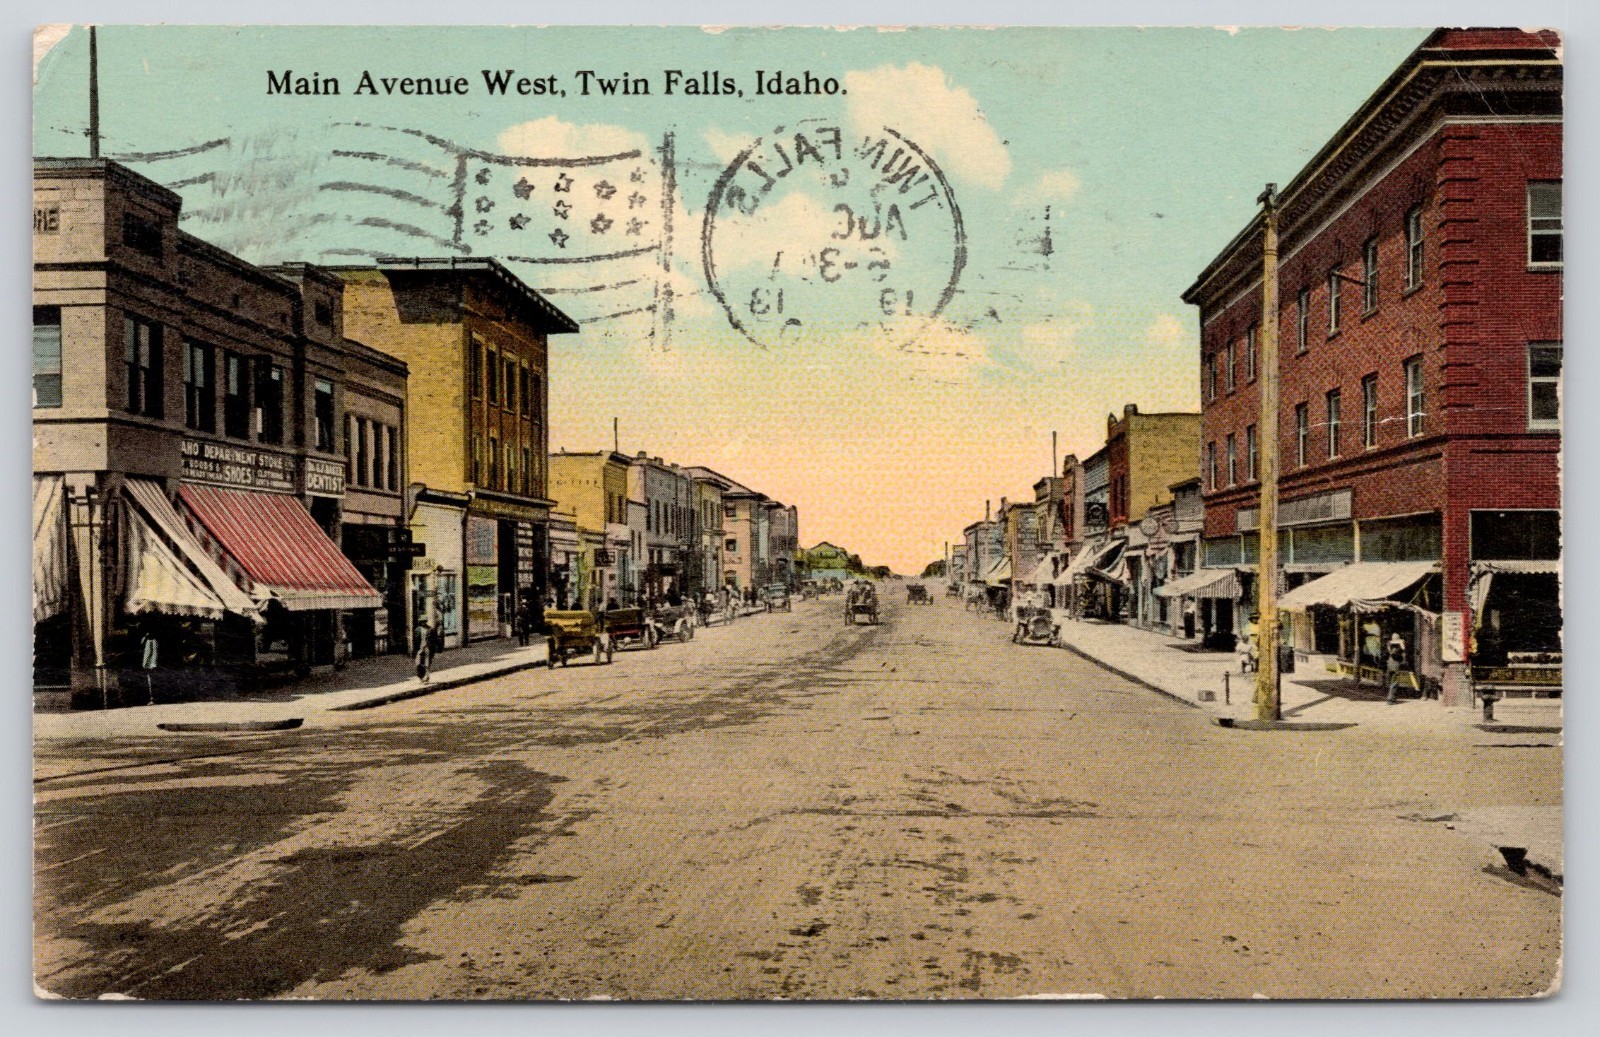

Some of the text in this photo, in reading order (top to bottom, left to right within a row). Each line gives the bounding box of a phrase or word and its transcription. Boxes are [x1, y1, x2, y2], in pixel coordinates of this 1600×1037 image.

[34, 208, 60, 232] RE
[204, 444, 257, 466] DEPARTMENT
[223, 465, 252, 484] SHOES
